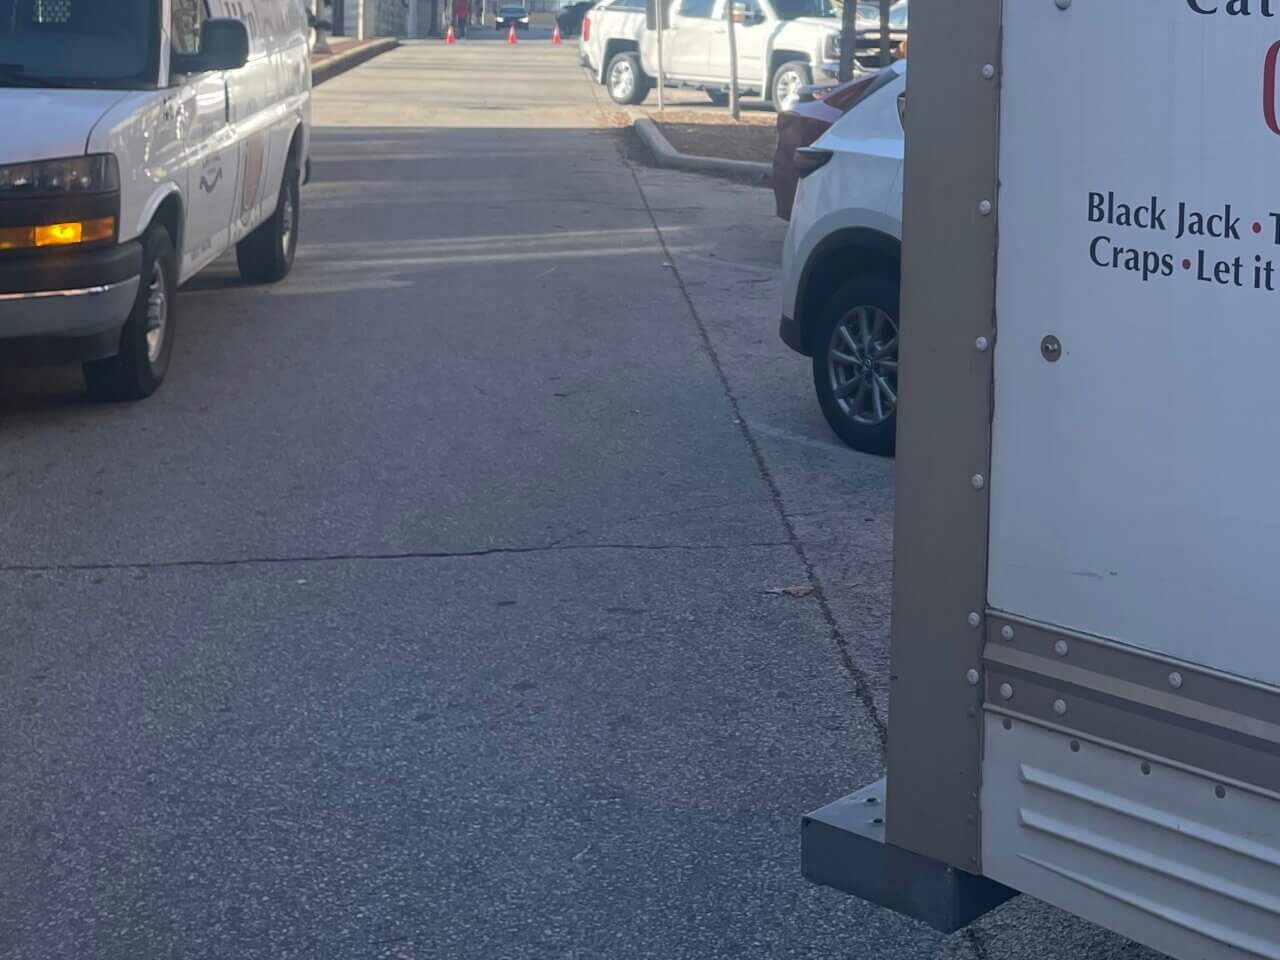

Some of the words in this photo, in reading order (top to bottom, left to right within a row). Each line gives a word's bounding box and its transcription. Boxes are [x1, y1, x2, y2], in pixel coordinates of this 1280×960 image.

[1088, 192, 1166, 231] Black
[1176, 202, 1241, 240] Jack
[1089, 236, 1174, 283] Craps
[1197, 250, 1242, 287] Let
[1253, 256, 1275, 292] it
